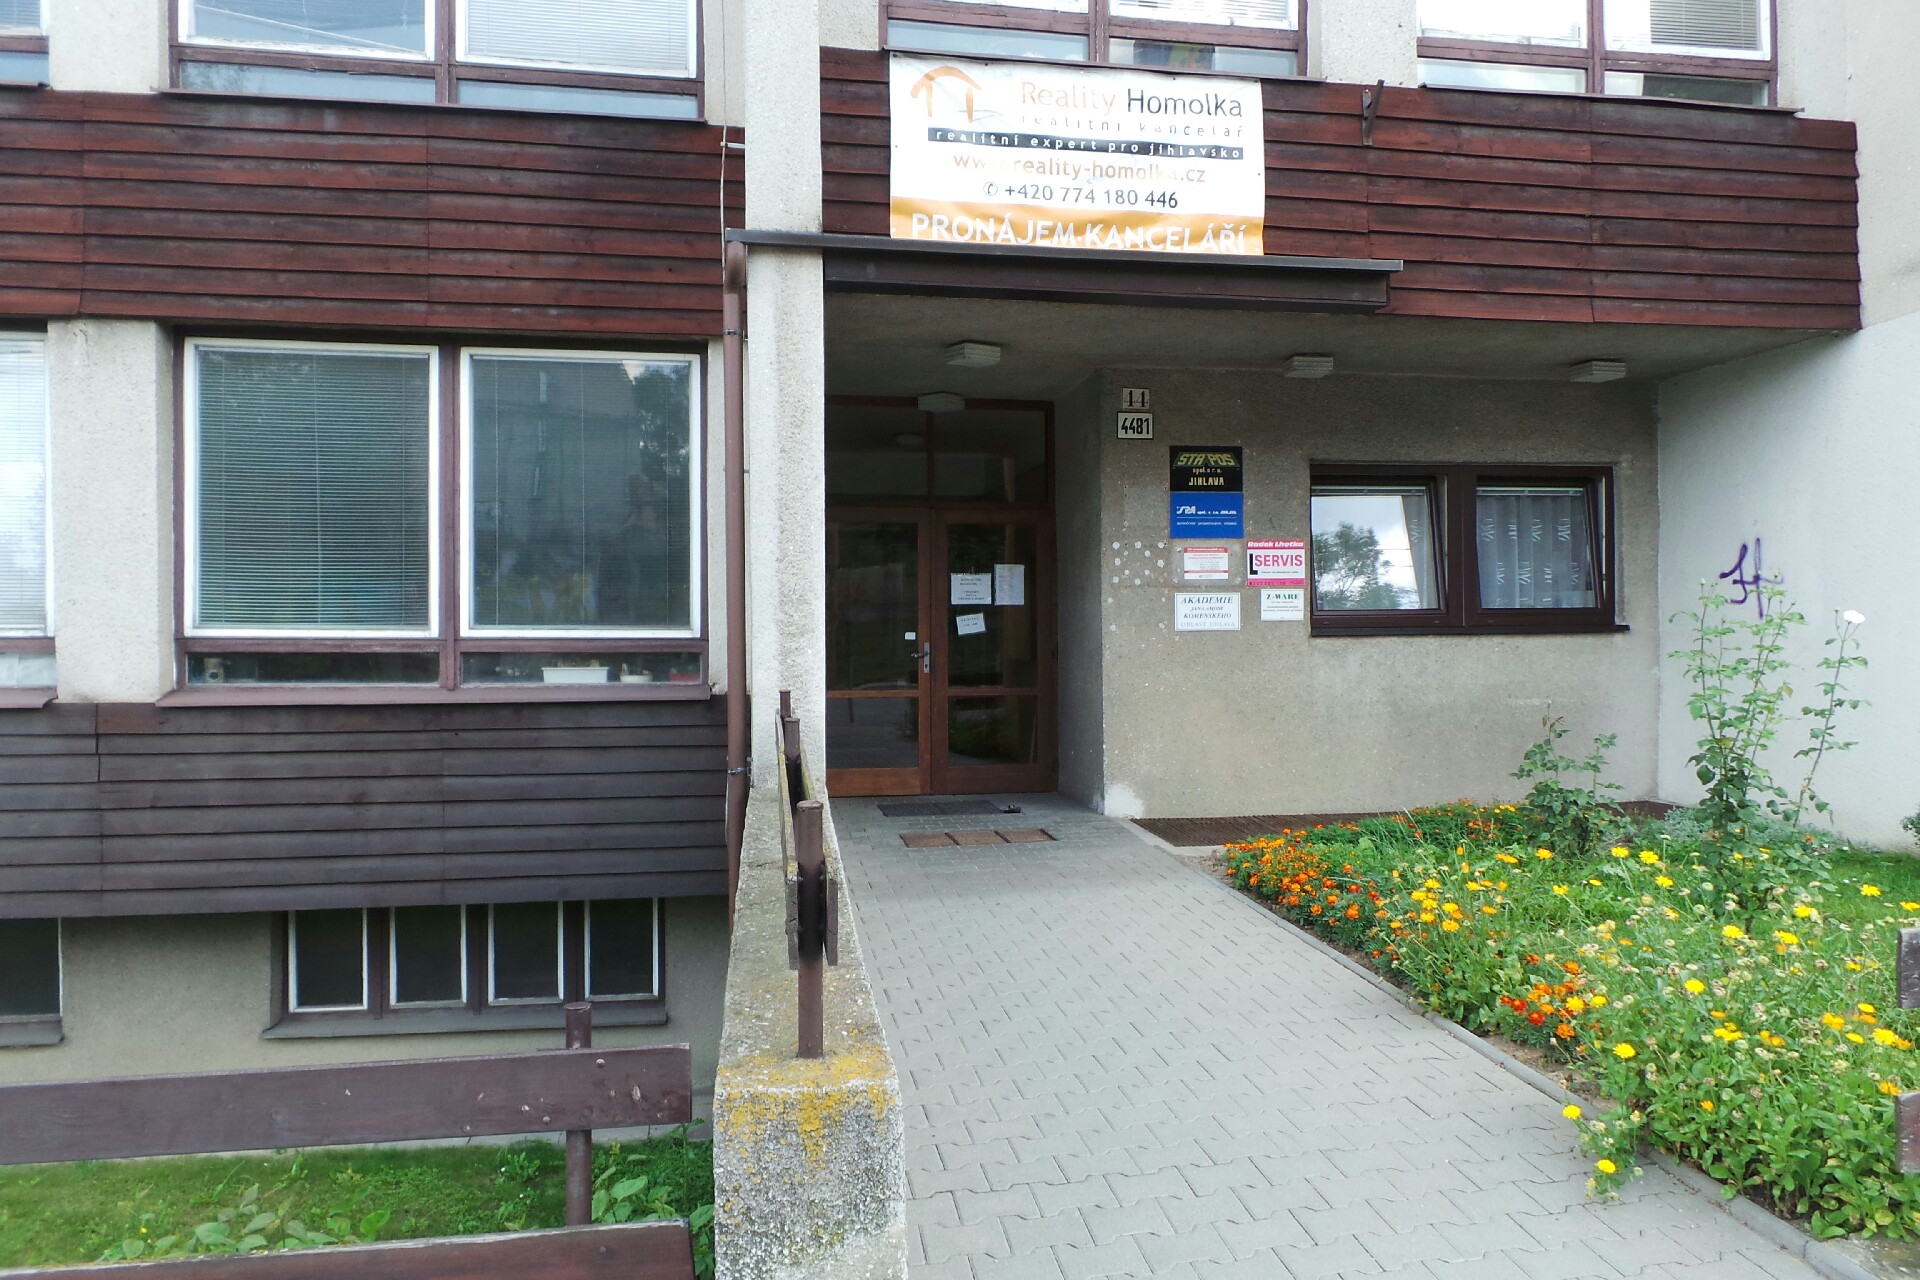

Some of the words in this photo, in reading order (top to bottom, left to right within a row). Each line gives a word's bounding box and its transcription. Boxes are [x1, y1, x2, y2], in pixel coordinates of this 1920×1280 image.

[1021, 80, 1116, 116] Reality
[1127, 88, 1243, 118] Homolka
[936, 130, 1019, 146] realitní
[1030, 137, 1097, 151] expert
[1108, 143, 1139, 154] pro
[1148, 143, 1241, 159] jihlavsko
[953, 154, 1206, 183] wwreality-homolka.cz
[1005, 183, 1054, 201] +420
[1060, 186, 1096, 205] 774
[1103, 189, 1139, 206] 180
[1144, 190, 1179, 209] 446
[911, 211, 1079, 246] PRONÁJEM
[1085, 222, 1247, 254] KANCELÁŘÍ
[1120, 417, 1150, 435] 4481
[1188, 476, 1225, 486] JIHLAVA
[1254, 554, 1303, 567] SERVIS
[1180, 596, 1233, 604] AKADEMIE
